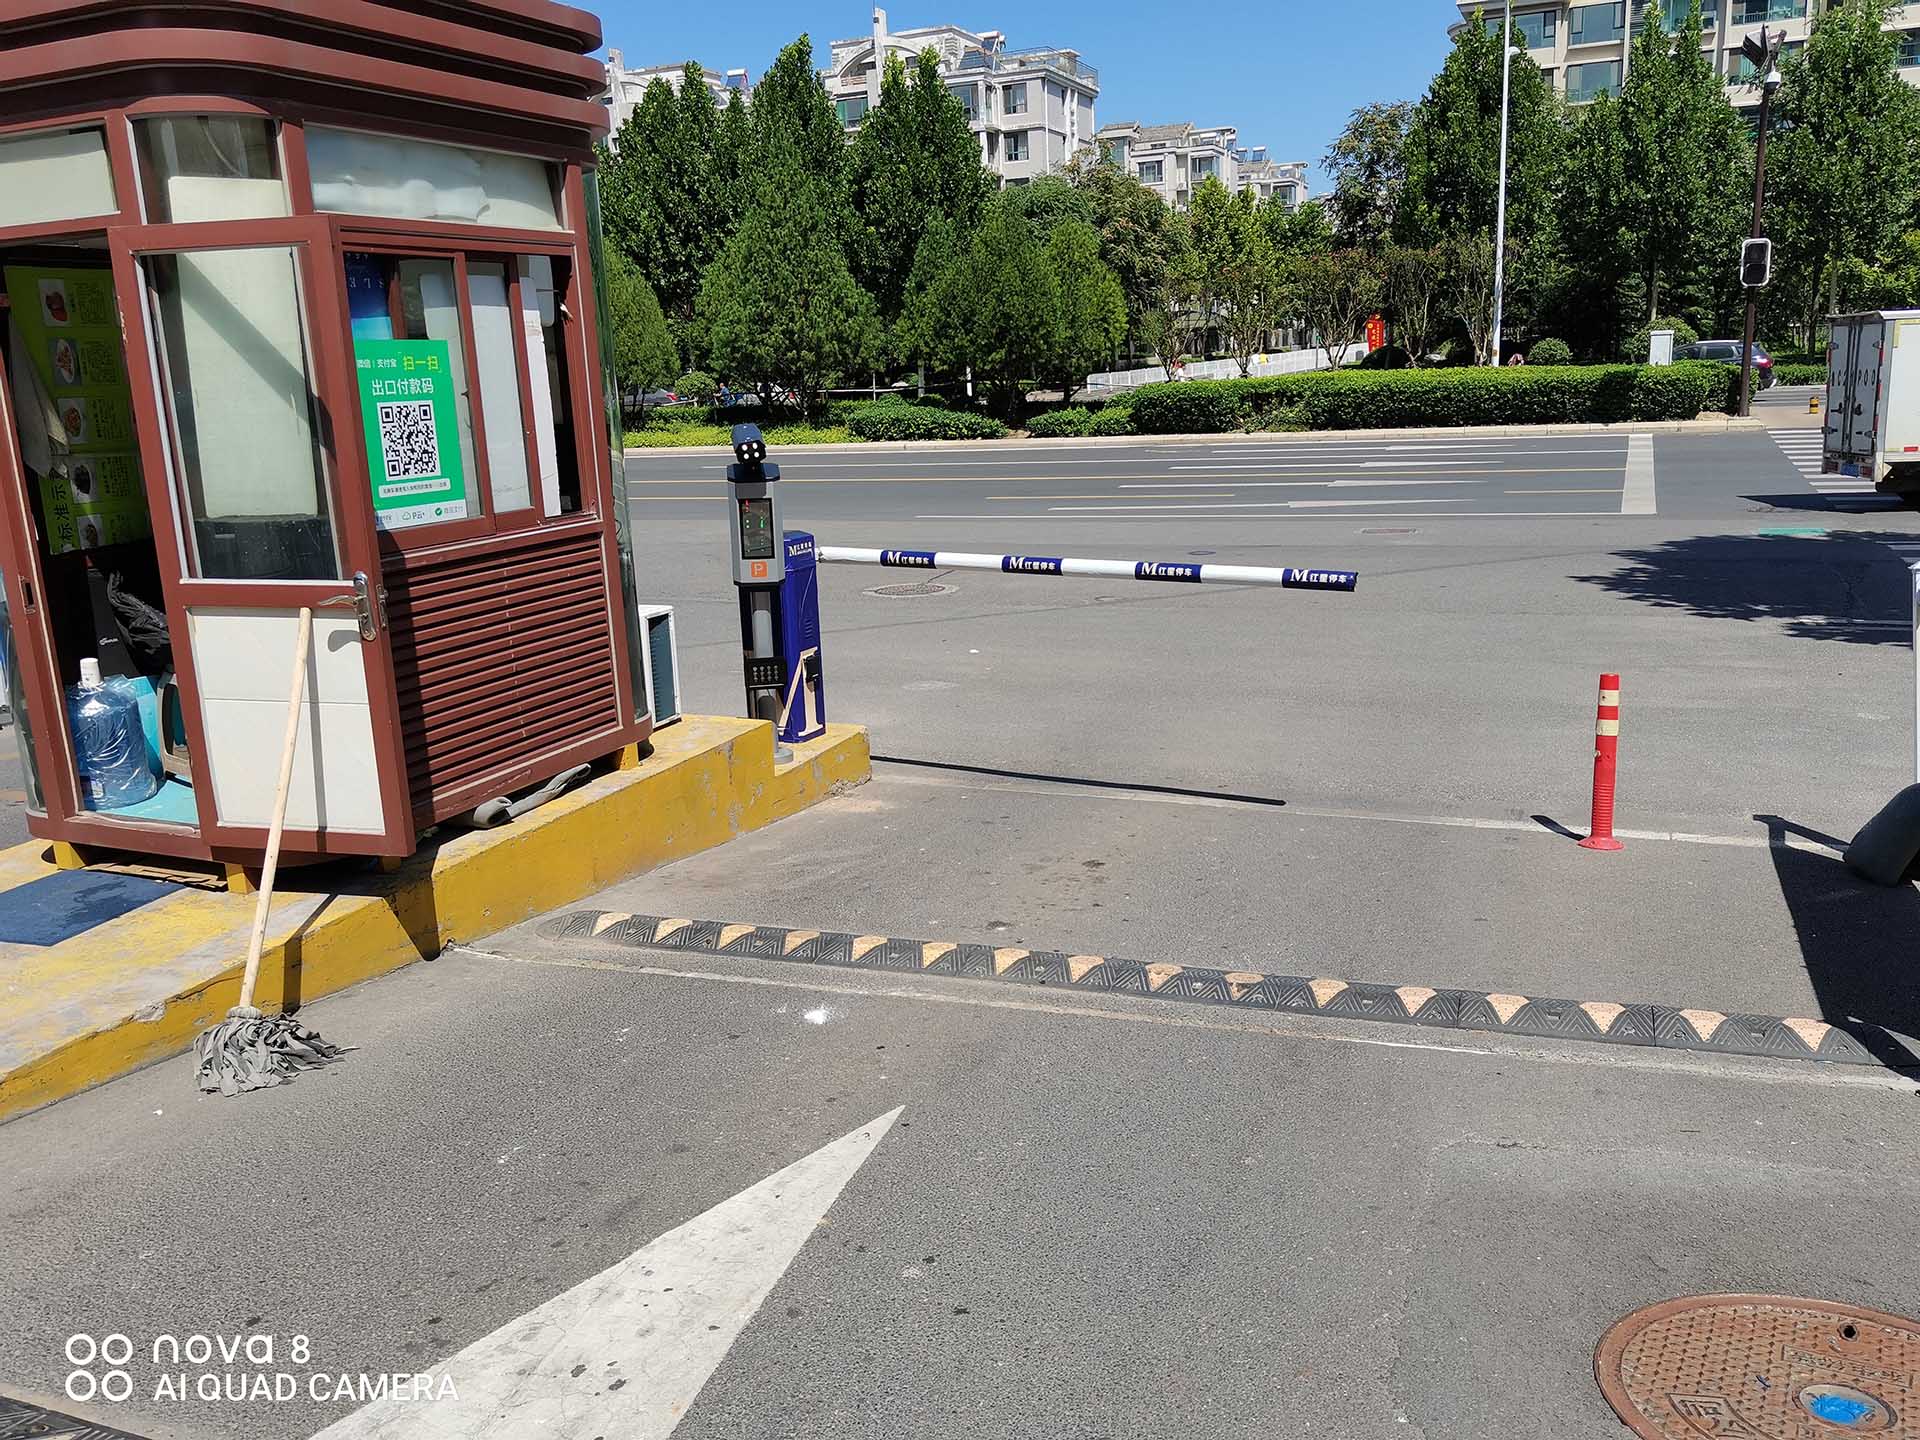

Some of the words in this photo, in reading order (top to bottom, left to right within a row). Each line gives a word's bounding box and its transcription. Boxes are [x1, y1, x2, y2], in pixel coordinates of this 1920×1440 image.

[403, 355, 439, 371] 扫一扫
[371, 378, 434, 396] 出口付款码
